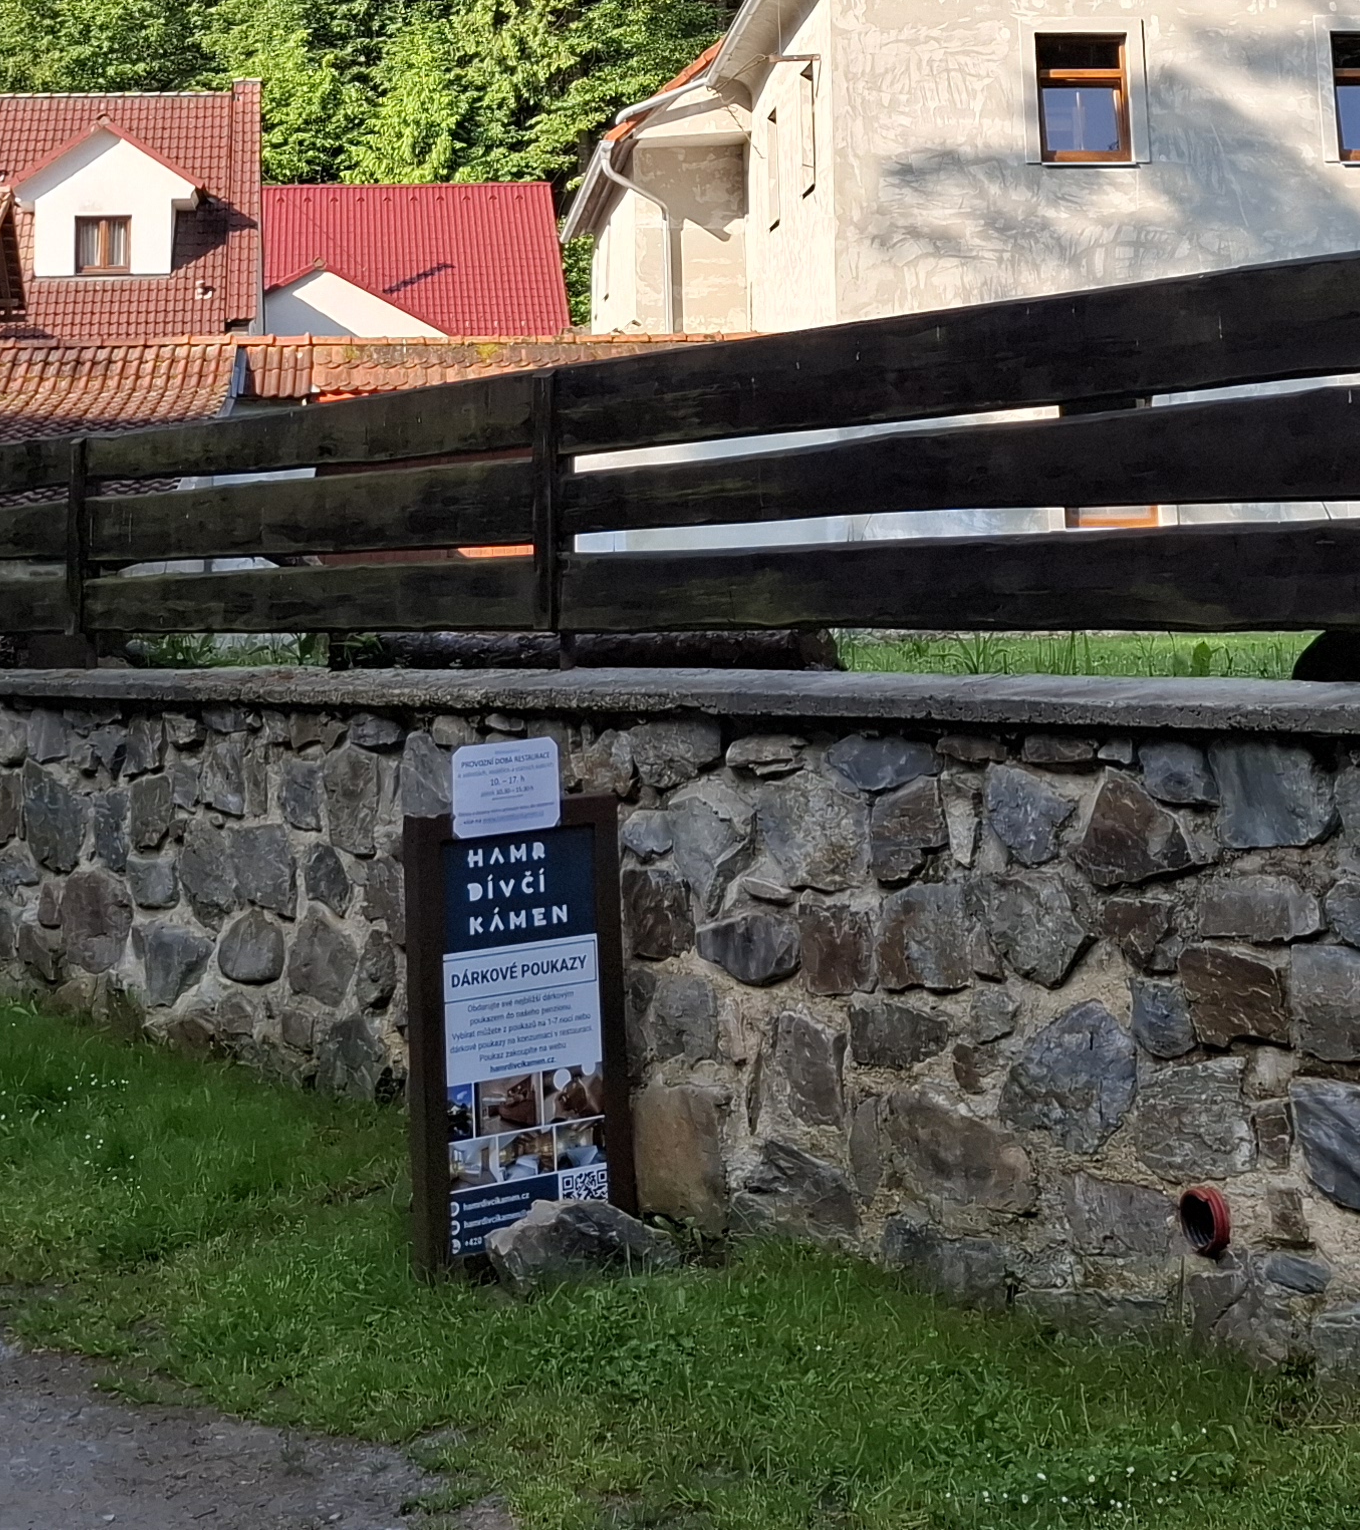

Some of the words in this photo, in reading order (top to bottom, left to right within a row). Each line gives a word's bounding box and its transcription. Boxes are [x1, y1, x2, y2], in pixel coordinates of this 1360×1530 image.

[495, 757, 513, 765] DOBA
[467, 841, 546, 868] HAMR
[467, 868, 545, 901] DÍVČÍ
[469, 904, 568, 936] KÁMEN
[451, 962, 518, 988] DÁRKOVÉ
[521, 954, 587, 978] POUKAZY
[501, 999, 513, 1008] své
[542, 990, 574, 1002] dárkovým
[469, 1014, 504, 1026] poukazem
[505, 1011, 515, 1019] do
[538, 1019, 546, 1027] na
[574, 1012, 591, 1022] nebo
[478, 1038, 506, 1051] poukazy
[507, 1037, 516, 1045] na
[479, 1052, 503, 1062] Poukaz
[549, 1042, 566, 1050] webu
